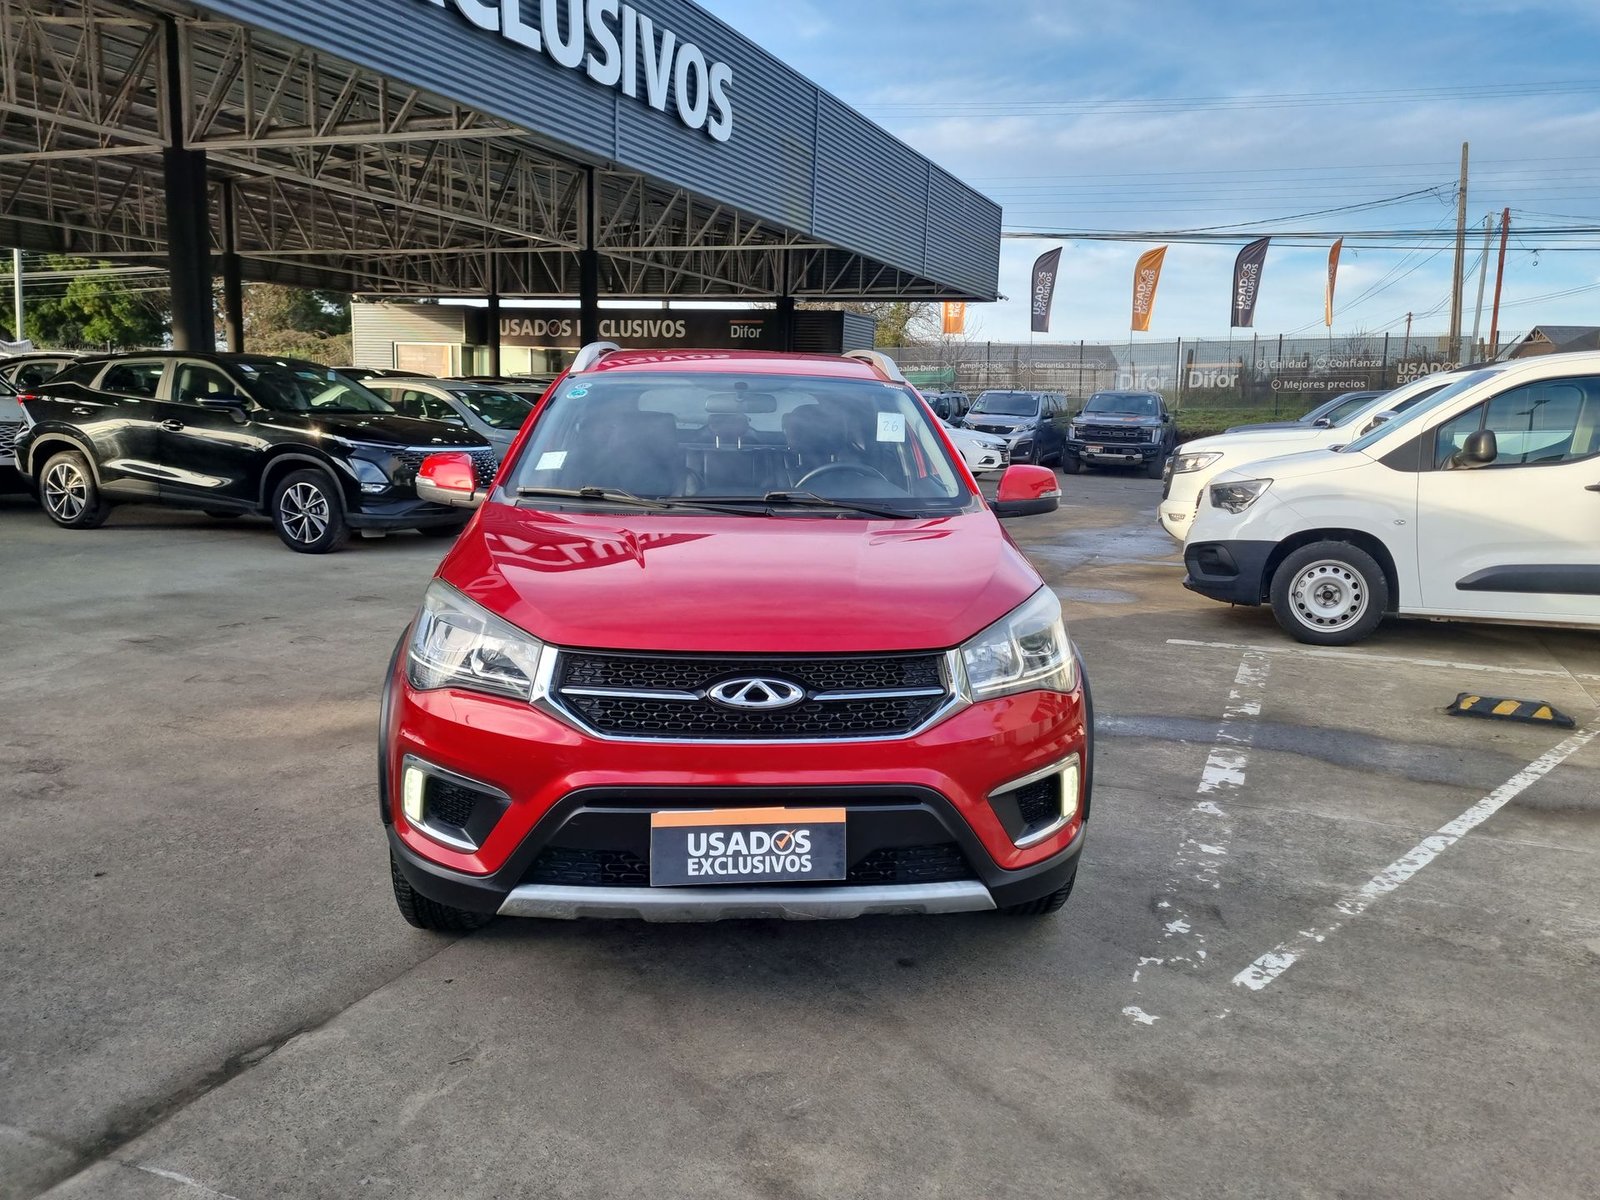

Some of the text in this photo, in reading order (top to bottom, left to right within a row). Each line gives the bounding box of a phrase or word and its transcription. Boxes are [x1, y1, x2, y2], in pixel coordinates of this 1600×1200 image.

[1033, 271, 1047, 315] USADOS
[1040, 272, 1053, 316] EXCLUSIVOS
[1134, 269, 1150, 314] USADOS
[1236, 263, 1252, 309] USADOS
[1244, 263, 1259, 310] EXCLUSIVOS
[499, 318, 686, 339] USADOS CLUSIVOS
[730, 325, 762, 339] Difor
[1269, 359, 1308, 369] Calidad
[1329, 359, 1382, 368] Confianza
[1120, 373, 1168, 390] Difor
[1188, 370, 1239, 388] Difor
[1283, 379, 1366, 391] Mejores precios
[687, 829, 811, 857] USADOS
[687, 854, 813, 876] EXCLUSIVOS
